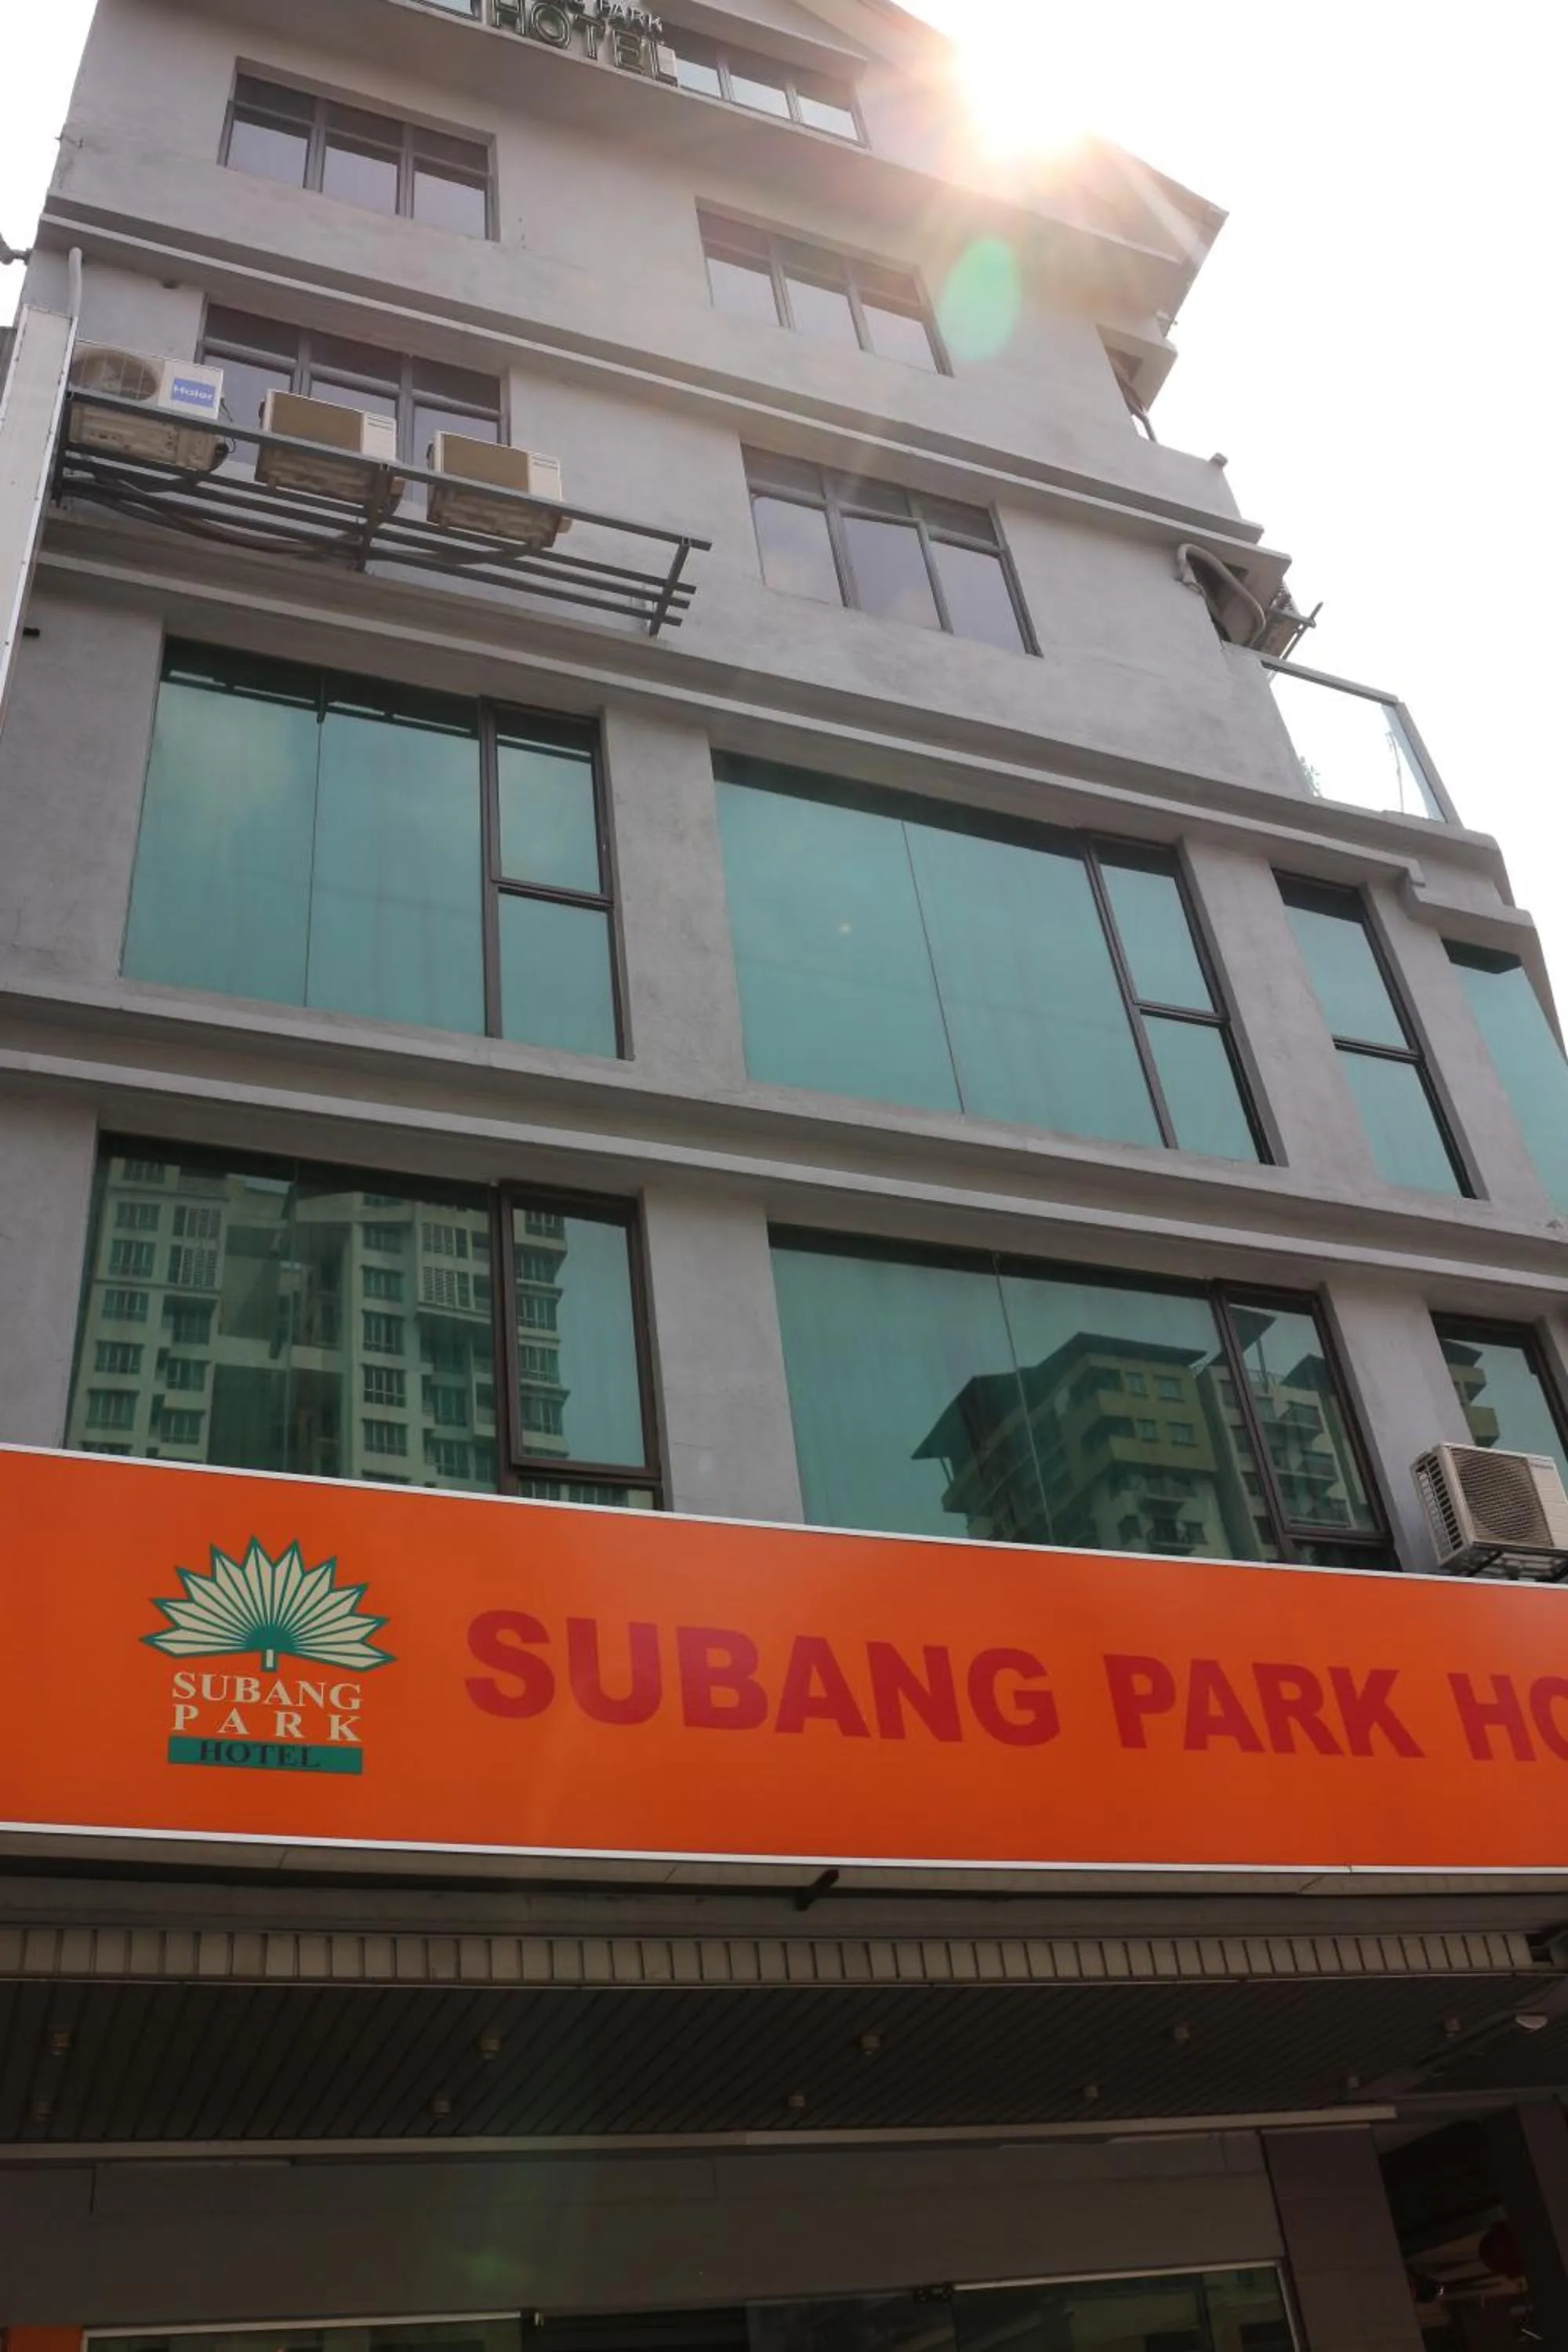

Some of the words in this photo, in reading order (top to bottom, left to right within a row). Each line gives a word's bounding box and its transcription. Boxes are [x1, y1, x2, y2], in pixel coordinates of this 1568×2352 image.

[492, 0, 679, 89] HOTEL
[172, 1671, 361, 1710] SUBANG
[464, 1610, 1061, 1747] SUBANG
[1103, 1653, 1426, 1758] PARK
[170, 1704, 362, 1742] PARK
[199, 1740, 321, 1768] HOTEL
